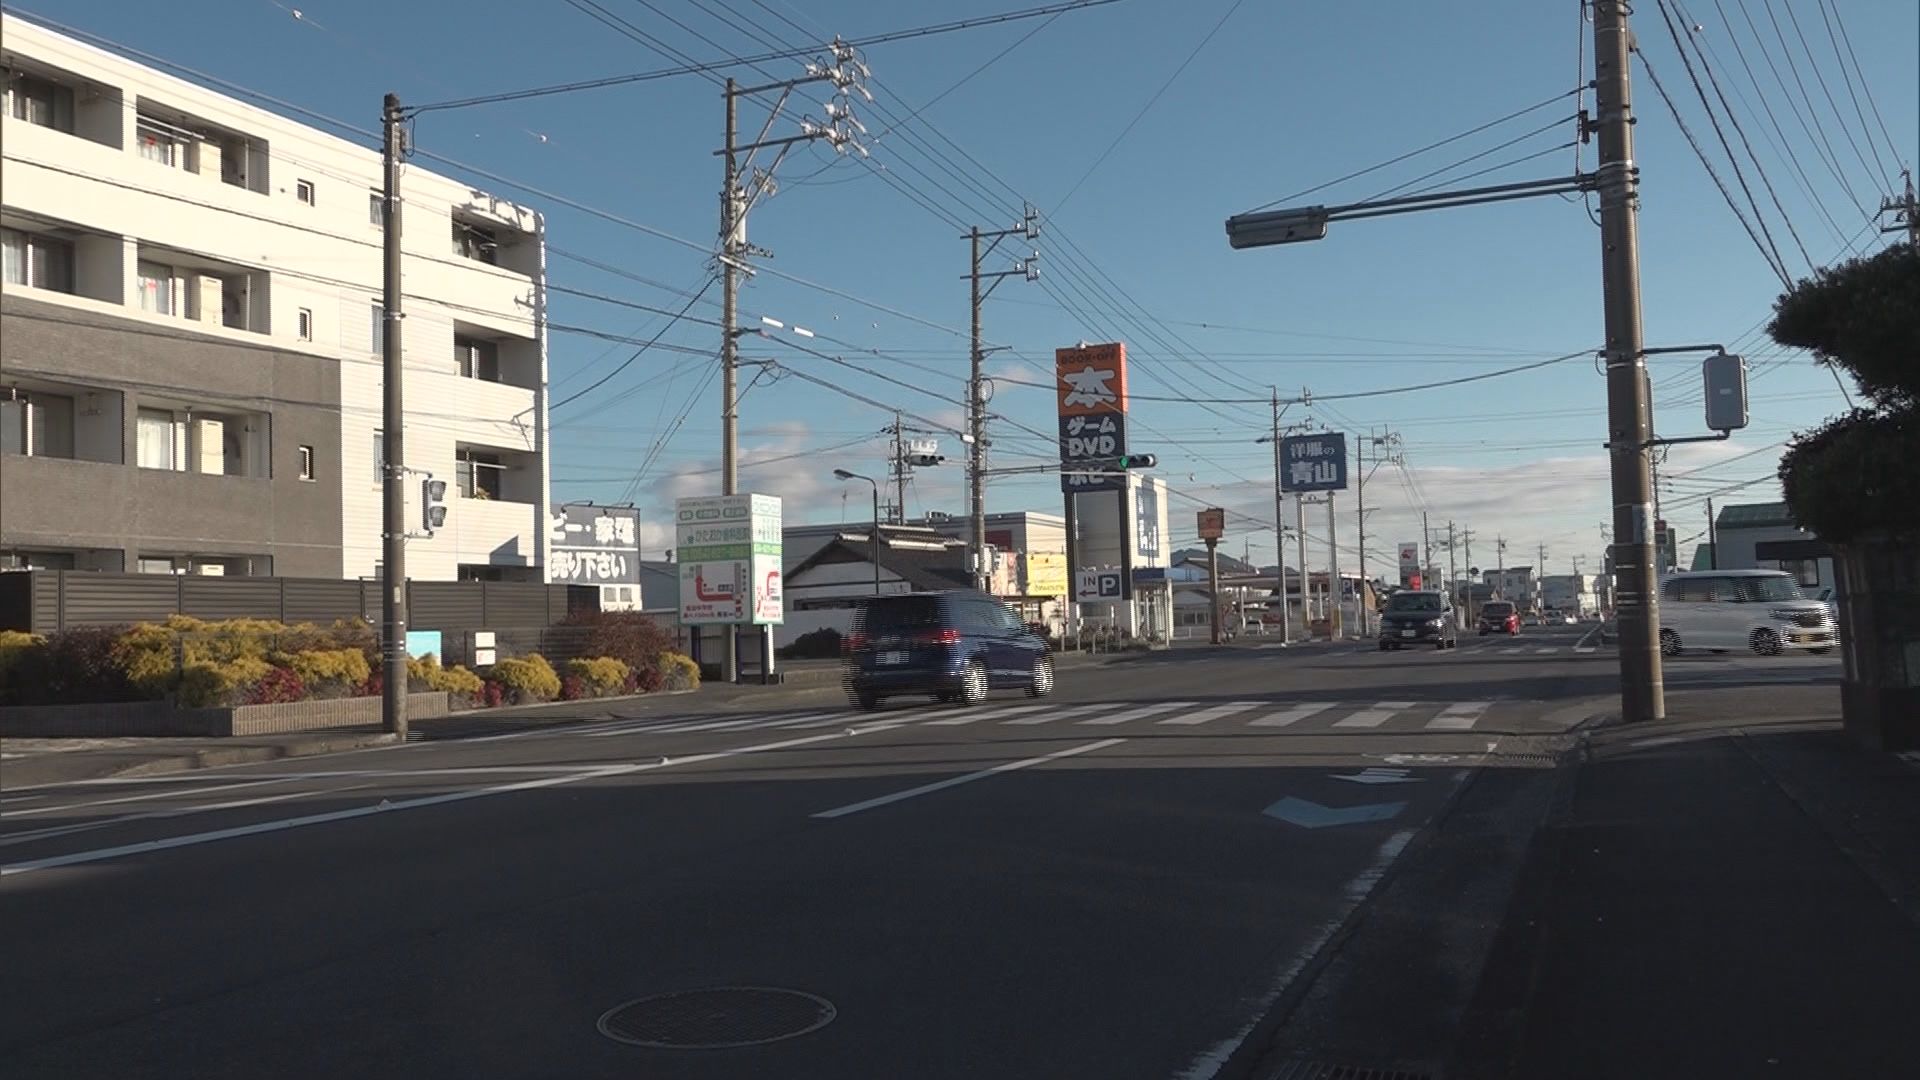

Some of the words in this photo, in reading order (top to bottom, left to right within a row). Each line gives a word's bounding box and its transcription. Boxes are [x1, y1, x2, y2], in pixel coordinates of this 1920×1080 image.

[1067, 416, 1117, 436] ゲーム
[1068, 435, 1116, 457] DVD
[1290, 460, 1337, 485] 青山
[1084, 576, 1096, 587] IN
[1102, 578, 1116, 594] P
